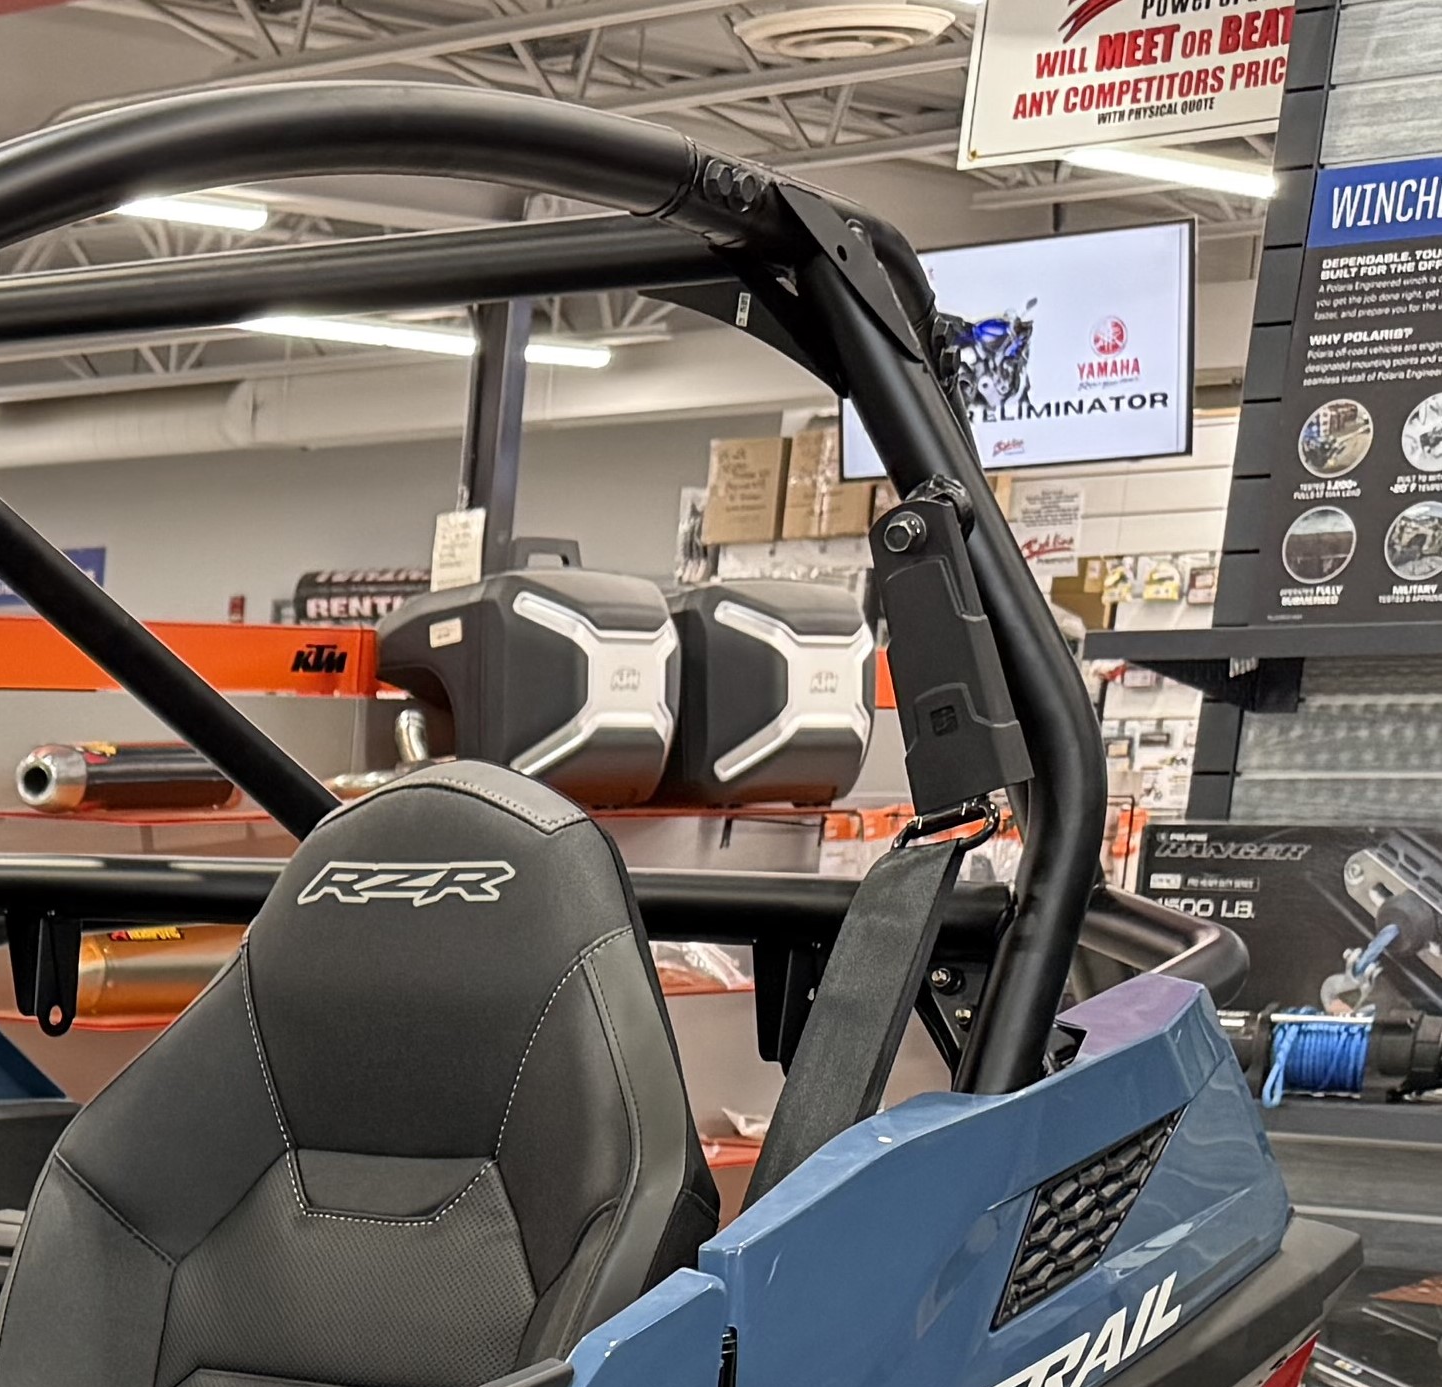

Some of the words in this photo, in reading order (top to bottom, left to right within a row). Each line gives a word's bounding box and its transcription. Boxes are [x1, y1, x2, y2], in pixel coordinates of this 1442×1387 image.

[1036, 47, 1087, 79] WILL
[1095, 24, 1180, 72] MEET
[1181, 29, 1212, 58] OR
[1218, 5, 1295, 55] BEAT
[1013, 89, 1059, 120] ANY
[1063, 66, 1225, 113] COMPETITORS
[1230, 56, 1287, 91] PRIC
[1097, 110, 1126, 125] WITH
[1128, 103, 1178, 121] PHYSICAL
[1181, 97, 1216, 112] QUOTE
[1332, 176, 1442, 229] WINCH
[1321, 267, 1358, 280] BUILT
[1360, 265, 1387, 276] FOR
[1390, 262, 1415, 274] THE
[1322, 252, 1412, 269] DEPENDABLE.
[1310, 334, 1341, 346] WHY
[1077, 357, 1141, 380] YAMAHA
[983, 392, 1168, 422] ELIMINATOR
[306, 595, 400, 620] RENT
[290, 643, 348, 674] KTM
[1155, 841, 1311, 861] RANGER
[297, 861, 515, 907] RZR
